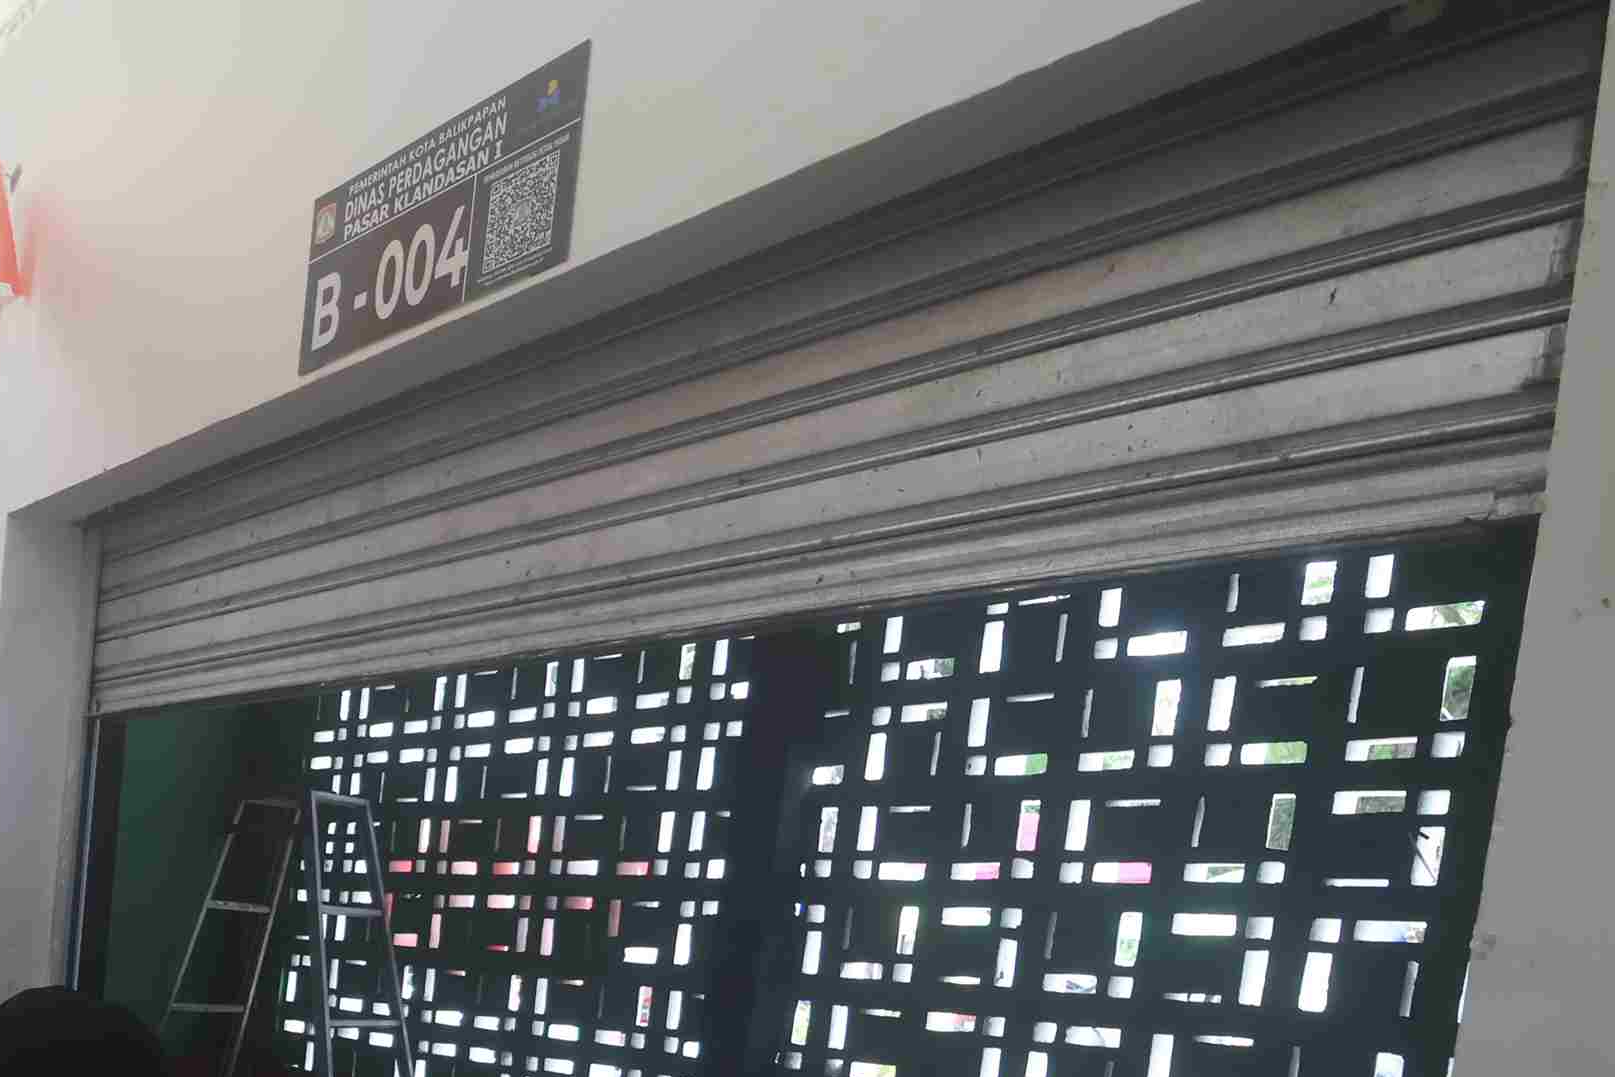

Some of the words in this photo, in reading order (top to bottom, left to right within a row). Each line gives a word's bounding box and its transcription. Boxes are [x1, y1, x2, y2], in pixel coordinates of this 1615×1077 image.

[344, 182, 384, 223] DINAS
[388, 112, 507, 198] PERDAGANGAN
[344, 203, 389, 241] PASAR
[394, 148, 489, 214] KLANDASAN
[494, 140, 503, 159] I
[349, 152, 406, 197] PEMERINTAH
[409, 138, 435, 161] KOTA
[439, 95, 506, 144] BALIKPAPAN
